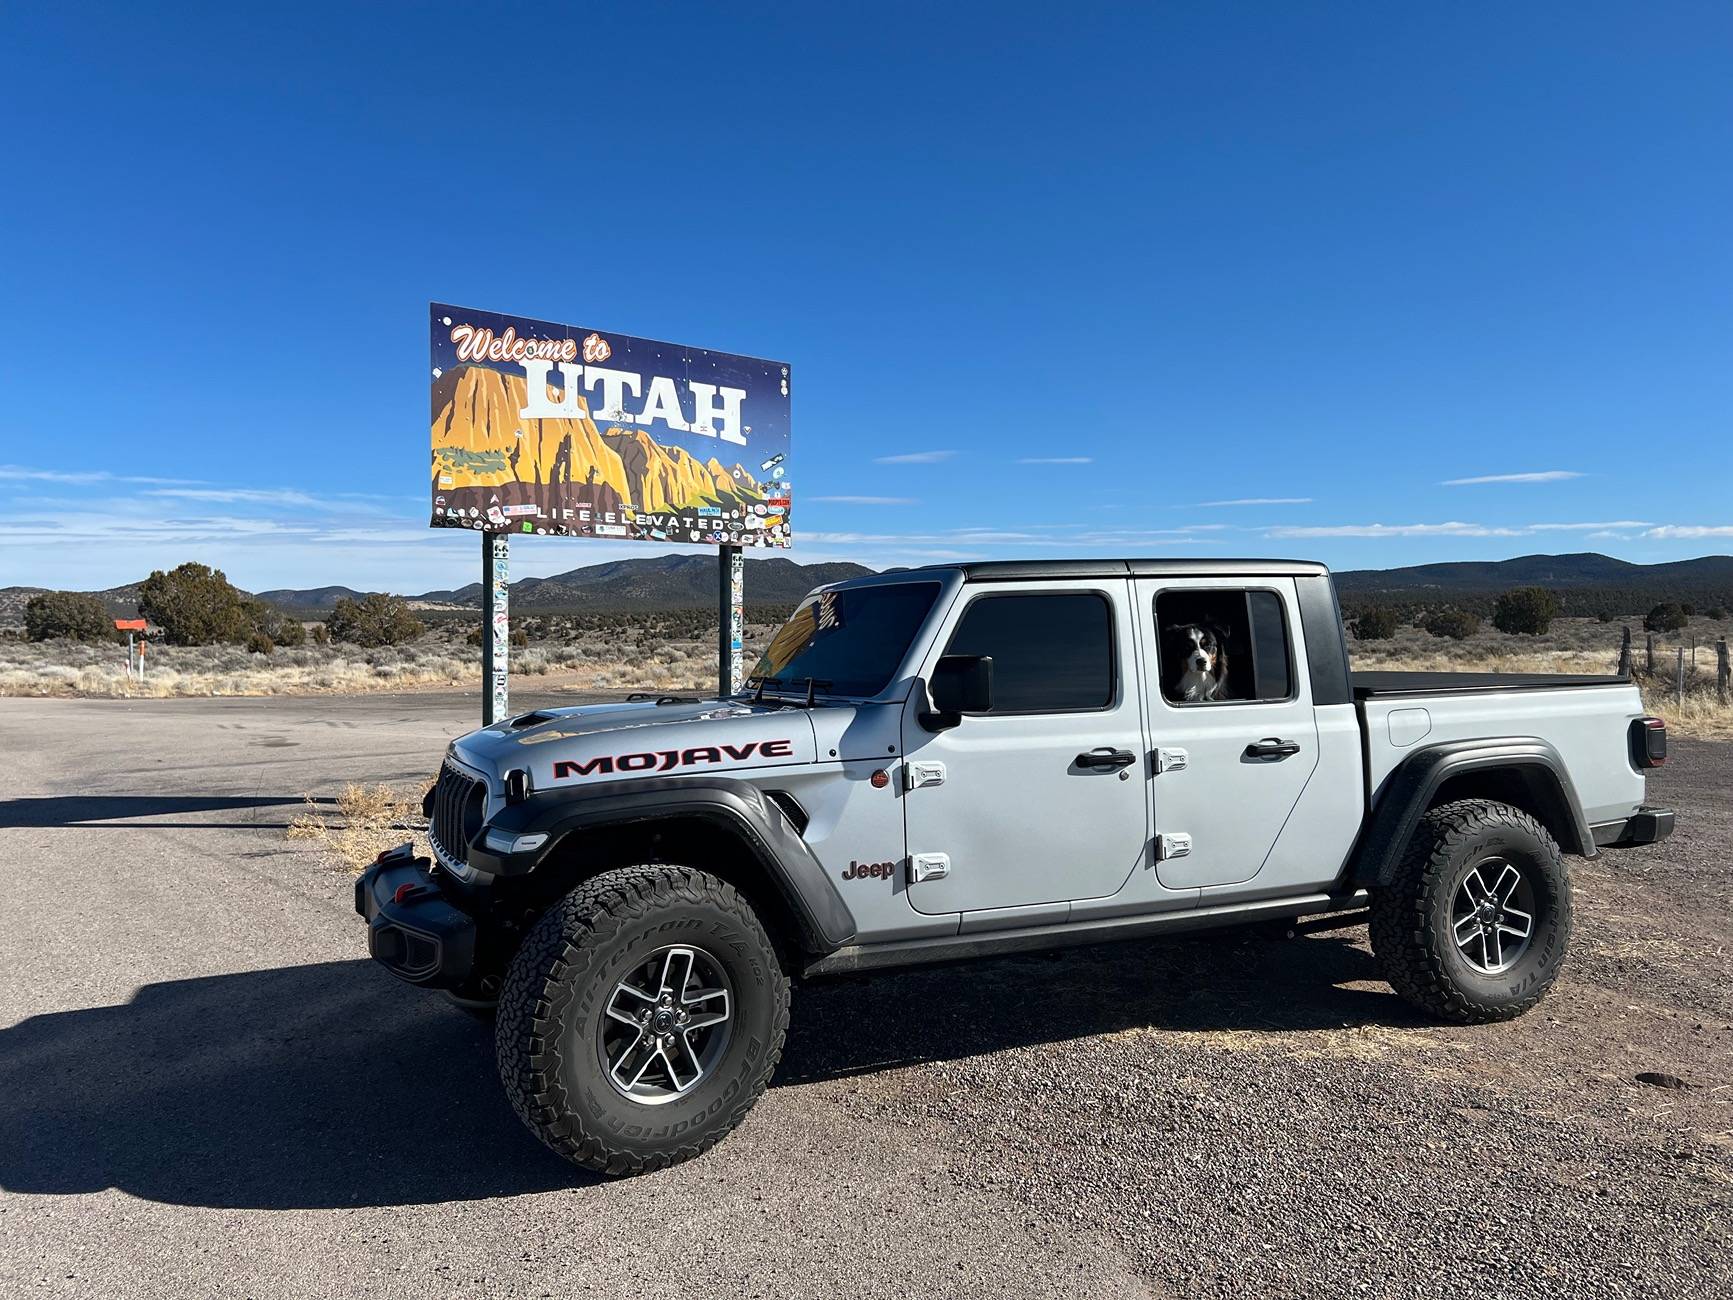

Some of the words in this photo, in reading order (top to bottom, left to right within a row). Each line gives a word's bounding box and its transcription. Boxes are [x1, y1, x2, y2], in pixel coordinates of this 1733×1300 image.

[451, 325, 576, 361] Welcome
[583, 333, 611, 362] to
[519, 360, 747, 446] UTAH
[536, 507, 591, 522] LIFE
[605, 512, 724, 531] ELEVATED
[553, 740, 793, 778] MOJAVE
[841, 860, 896, 881] Jeep
